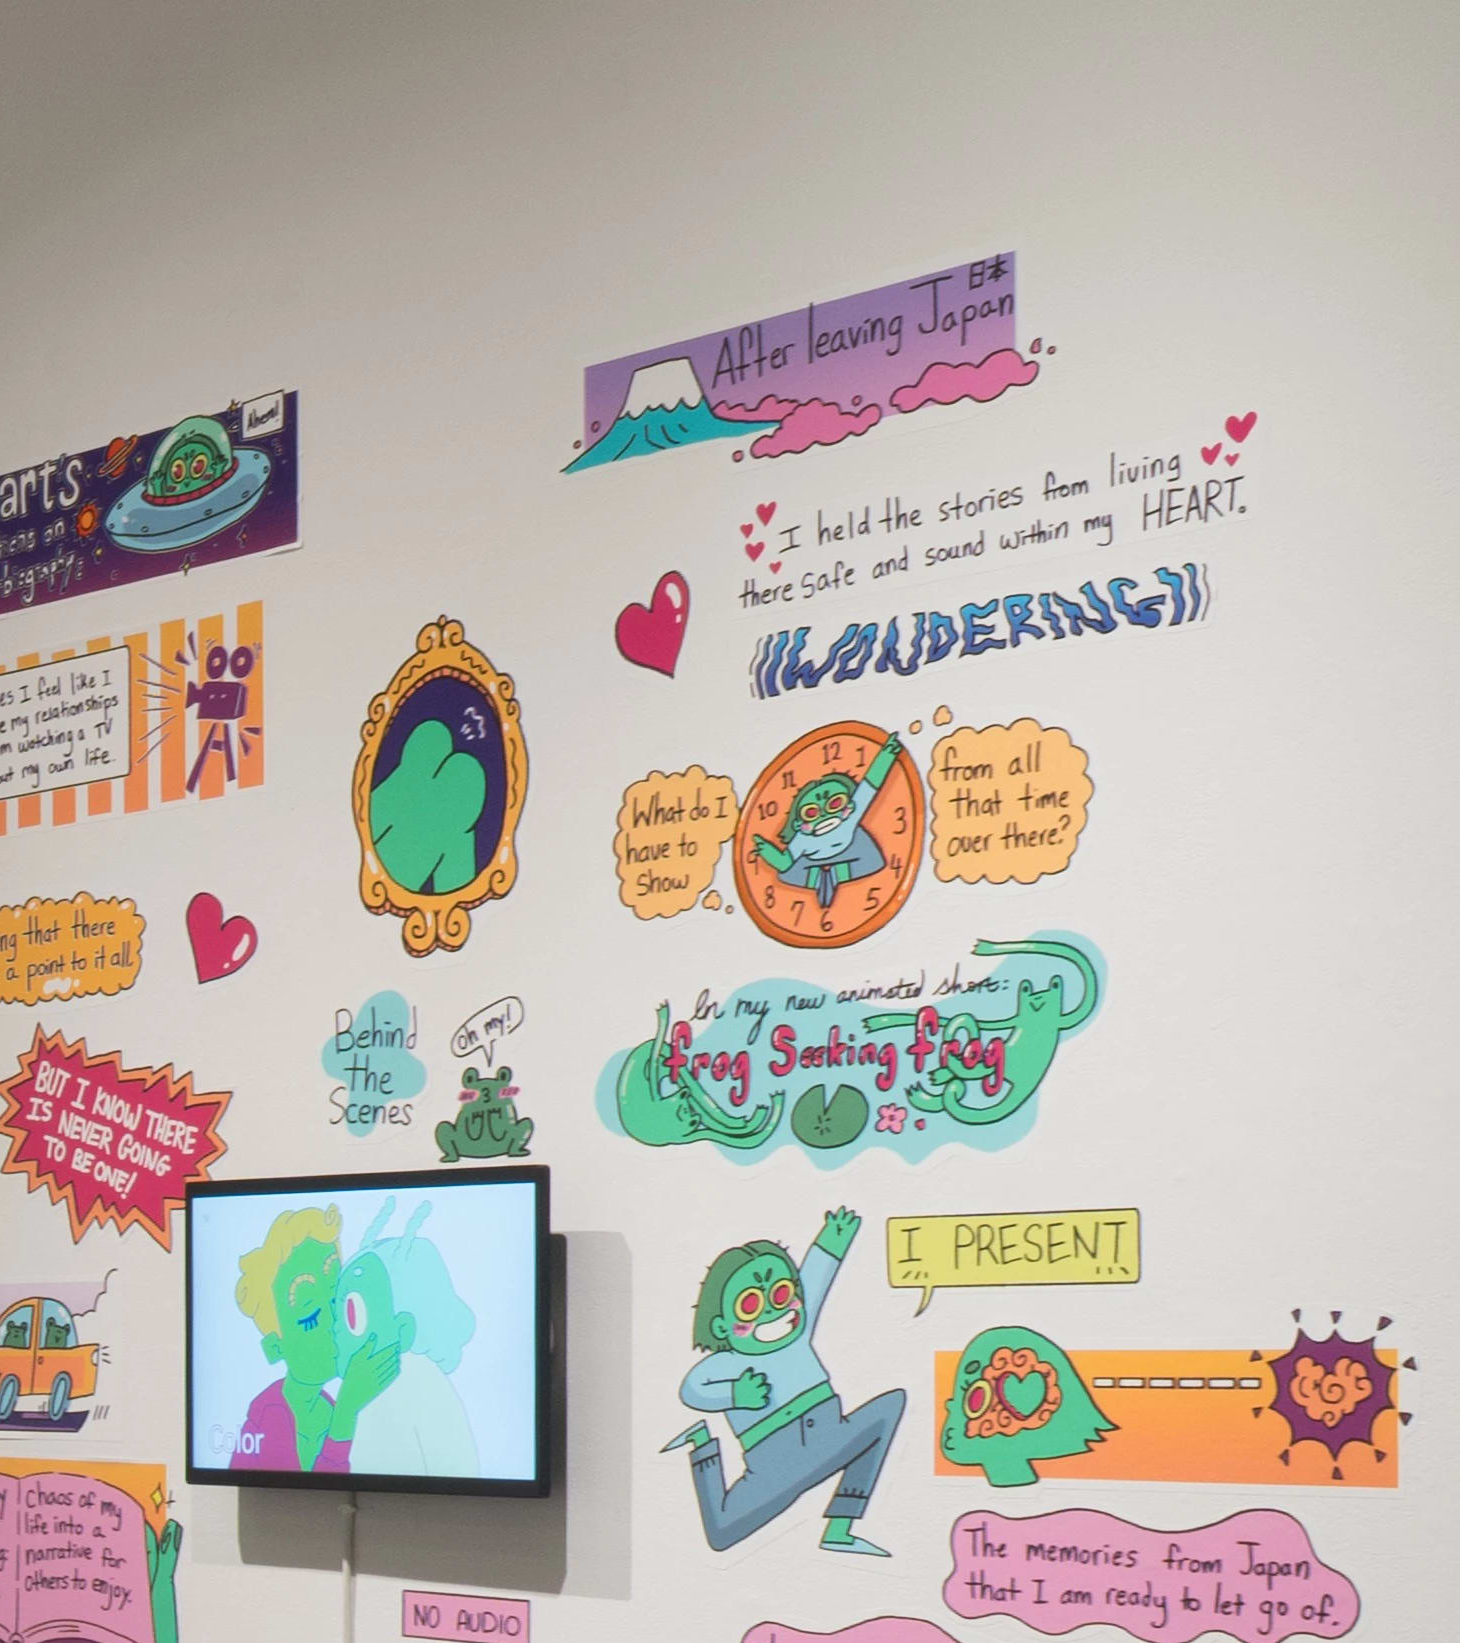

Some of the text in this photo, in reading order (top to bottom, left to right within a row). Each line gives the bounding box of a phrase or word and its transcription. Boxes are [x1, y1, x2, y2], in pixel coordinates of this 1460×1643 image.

[968, 255, 1008, 291] 日本
[712, 275, 1015, 389] After leaving Japan
[778, 452, 1182, 554] I held the stories from living
[44, 519, 66, 543] on
[739, 476, 1247, 608] there and sound within my HEART.
[37, 677, 61, 700] feel
[71, 672, 96, 694] like
[11, 716, 28, 737] my
[35, 695, 118, 724] relationships
[18, 730, 74, 757] watching
[95, 718, 112, 739] TV
[823, 741, 842, 767] 12
[22, 763, 40, 788] my
[48, 757, 74, 774] own
[939, 741, 1042, 783] from all
[632, 796, 710, 828] What do
[758, 801, 778, 820] 10
[894, 806, 906, 834] 3
[950, 788, 1070, 817] that time
[626, 833, 698, 864] have to
[947, 814, 1070, 857] over there?
[890, 854, 903, 878] 4
[764, 886, 775, 909] 8
[791, 902, 805, 926] 7
[864, 887, 880, 911] 5
[23, 916, 61, 945] that
[71, 909, 115, 939] there
[821, 906, 834, 932] 6
[26, 955, 65, 991] point
[70, 954, 86, 972] to
[735, 998, 770, 1043] my
[785, 993, 825, 1013] new
[836, 970, 924, 1003] animated
[335, 1006, 417, 1054] Behind
[344, 1054, 394, 1094] the
[664, 1020, 750, 1106] frog
[907, 1006, 1006, 1096] frog
[35, 1060, 198, 1155] BUT KNOW THERE
[329, 1086, 413, 1125] Scenes
[26, 1098, 171, 1177] IS NEVER GOING
[43, 1136, 138, 1199] TO BE ONE!
[954, 1221, 1127, 1269] PRESENT
[209, 1424, 264, 1456] Color
[26, 1512, 83, 1535] life into
[79, 1492, 122, 1531] of my
[26, 1543, 126, 1569] narrative for
[963, 1522, 1311, 1590] The memories from Japan
[25, 1570, 68, 1591] others
[72, 1568, 87, 1589] to
[414, 1604, 522, 1636] NO AUDIO
[964, 1573, 1340, 1634] that am ready to let go of.
